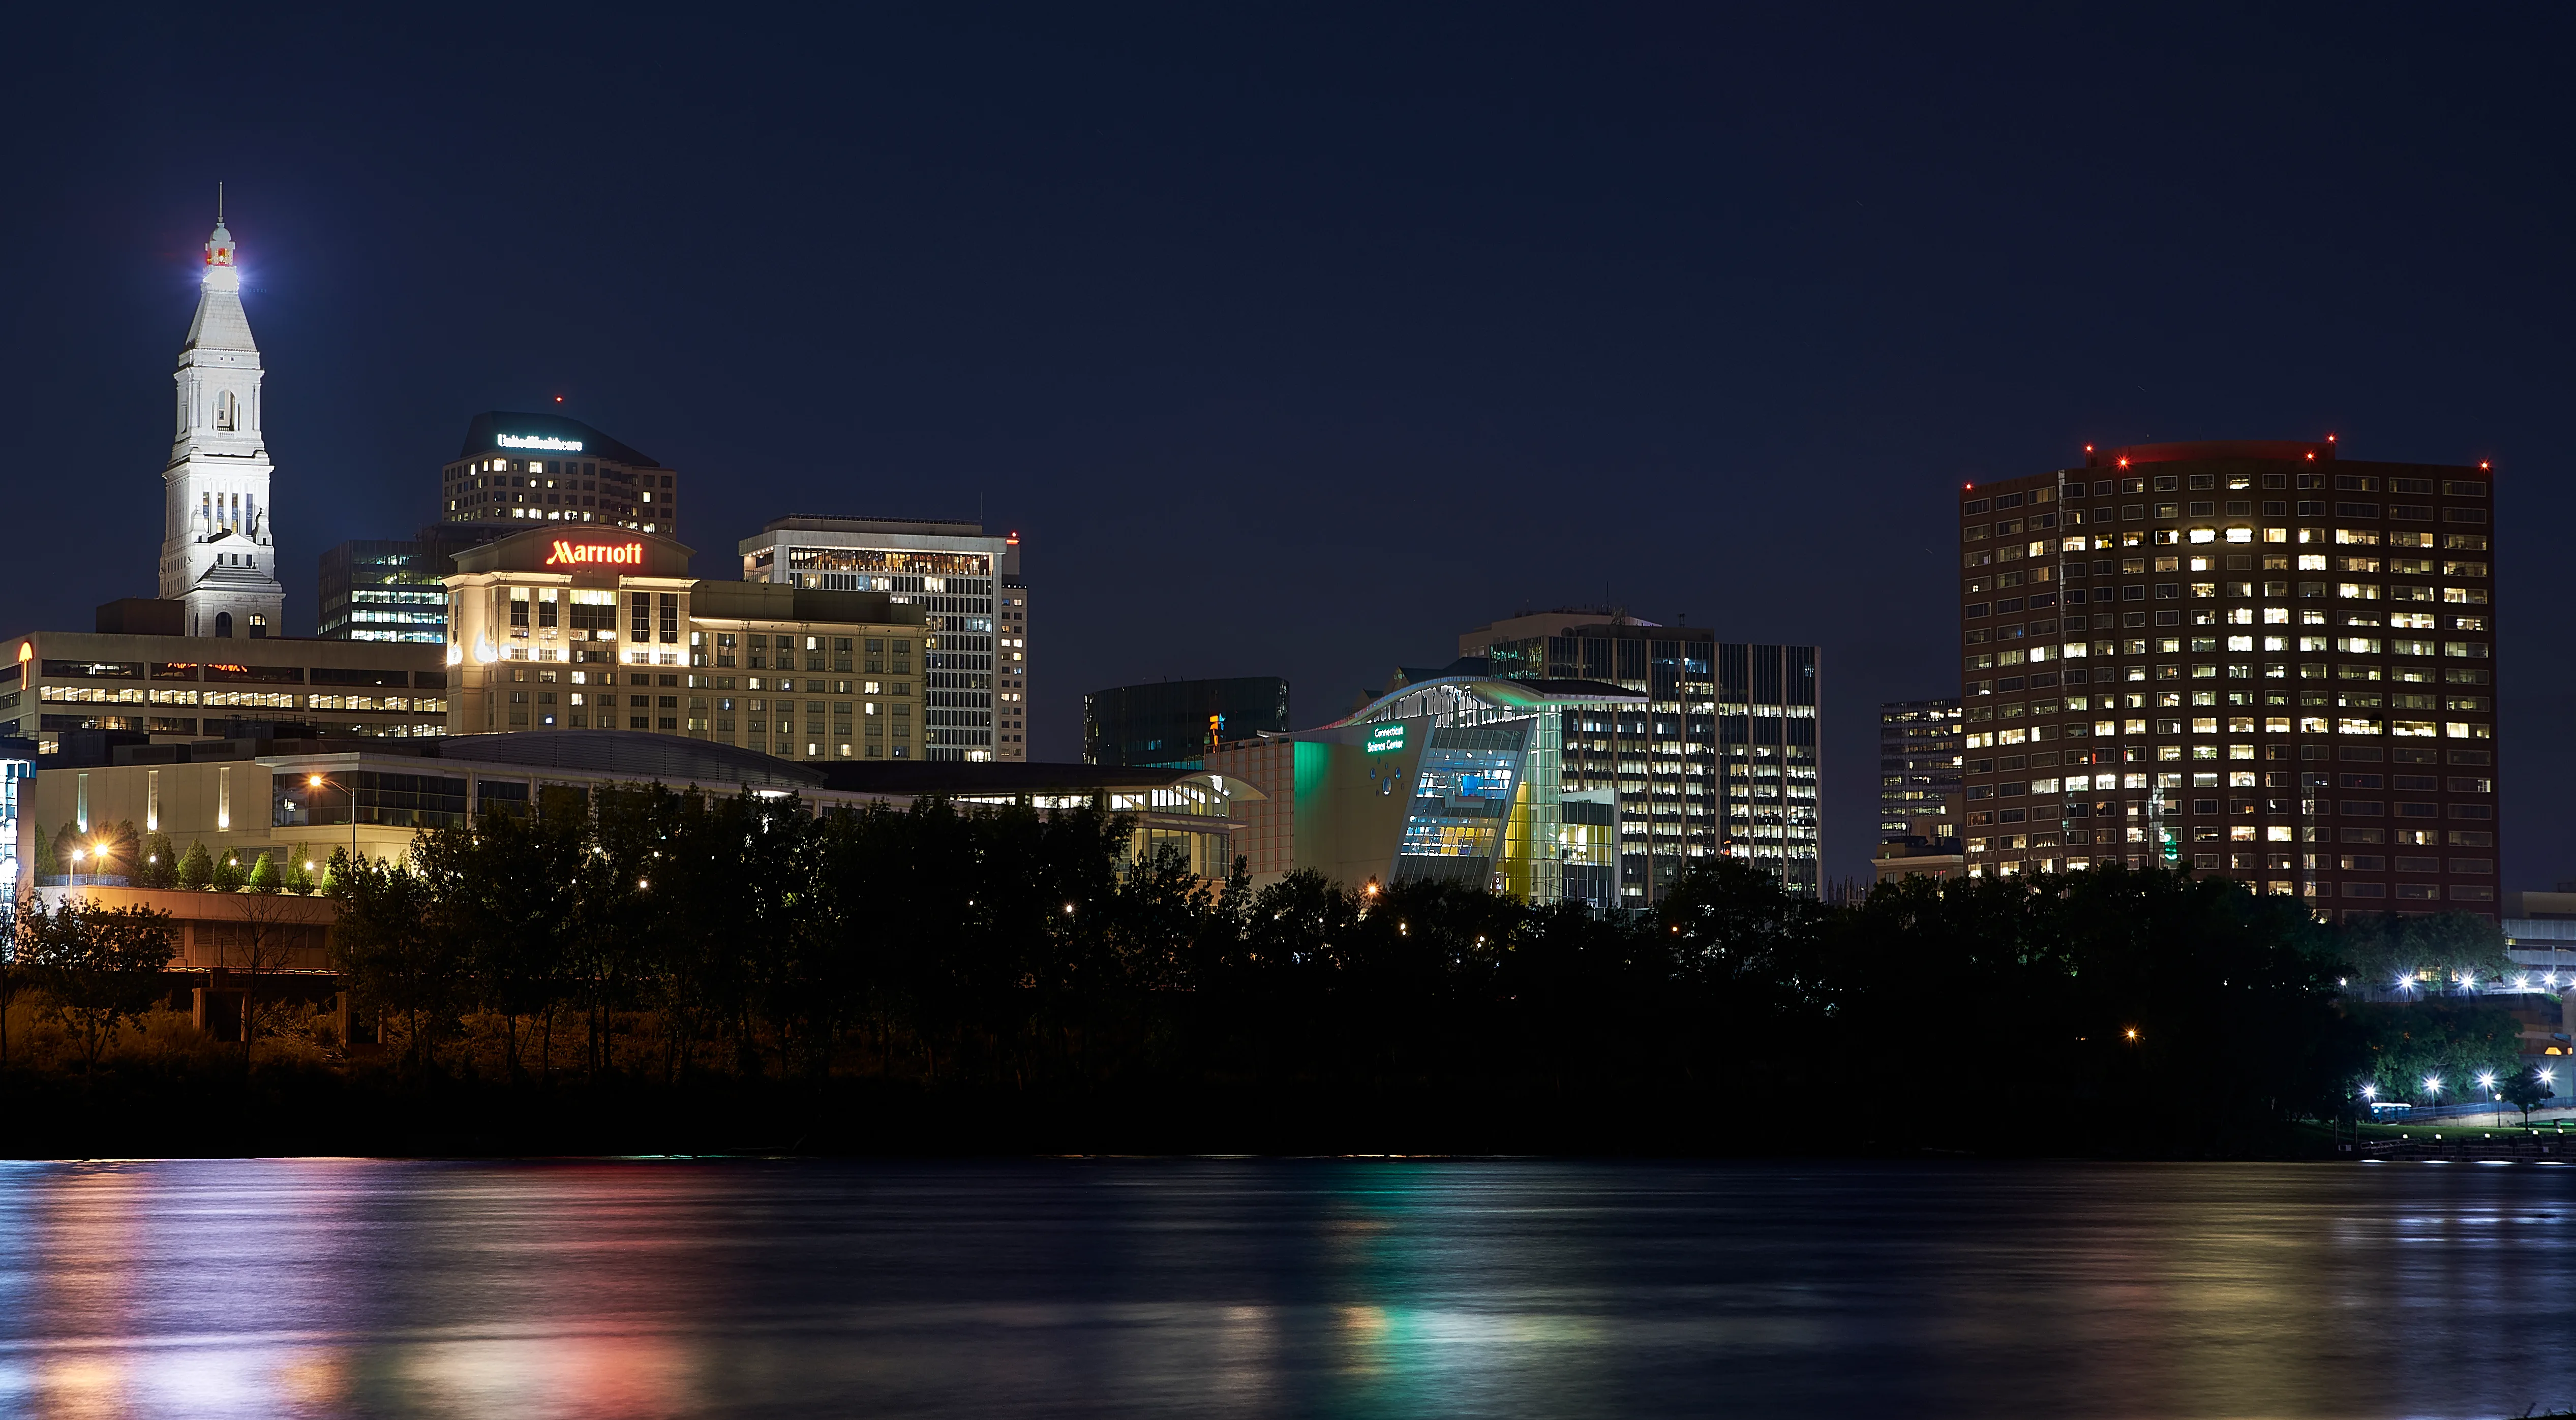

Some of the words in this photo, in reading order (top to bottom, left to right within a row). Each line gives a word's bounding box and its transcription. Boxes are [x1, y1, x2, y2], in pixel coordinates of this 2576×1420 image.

[545, 540, 643, 565] Marriott
[1374, 726, 1404, 738] Connecticut
[1367, 742, 1386, 753] Science
[1386, 739, 1404, 750] Center
